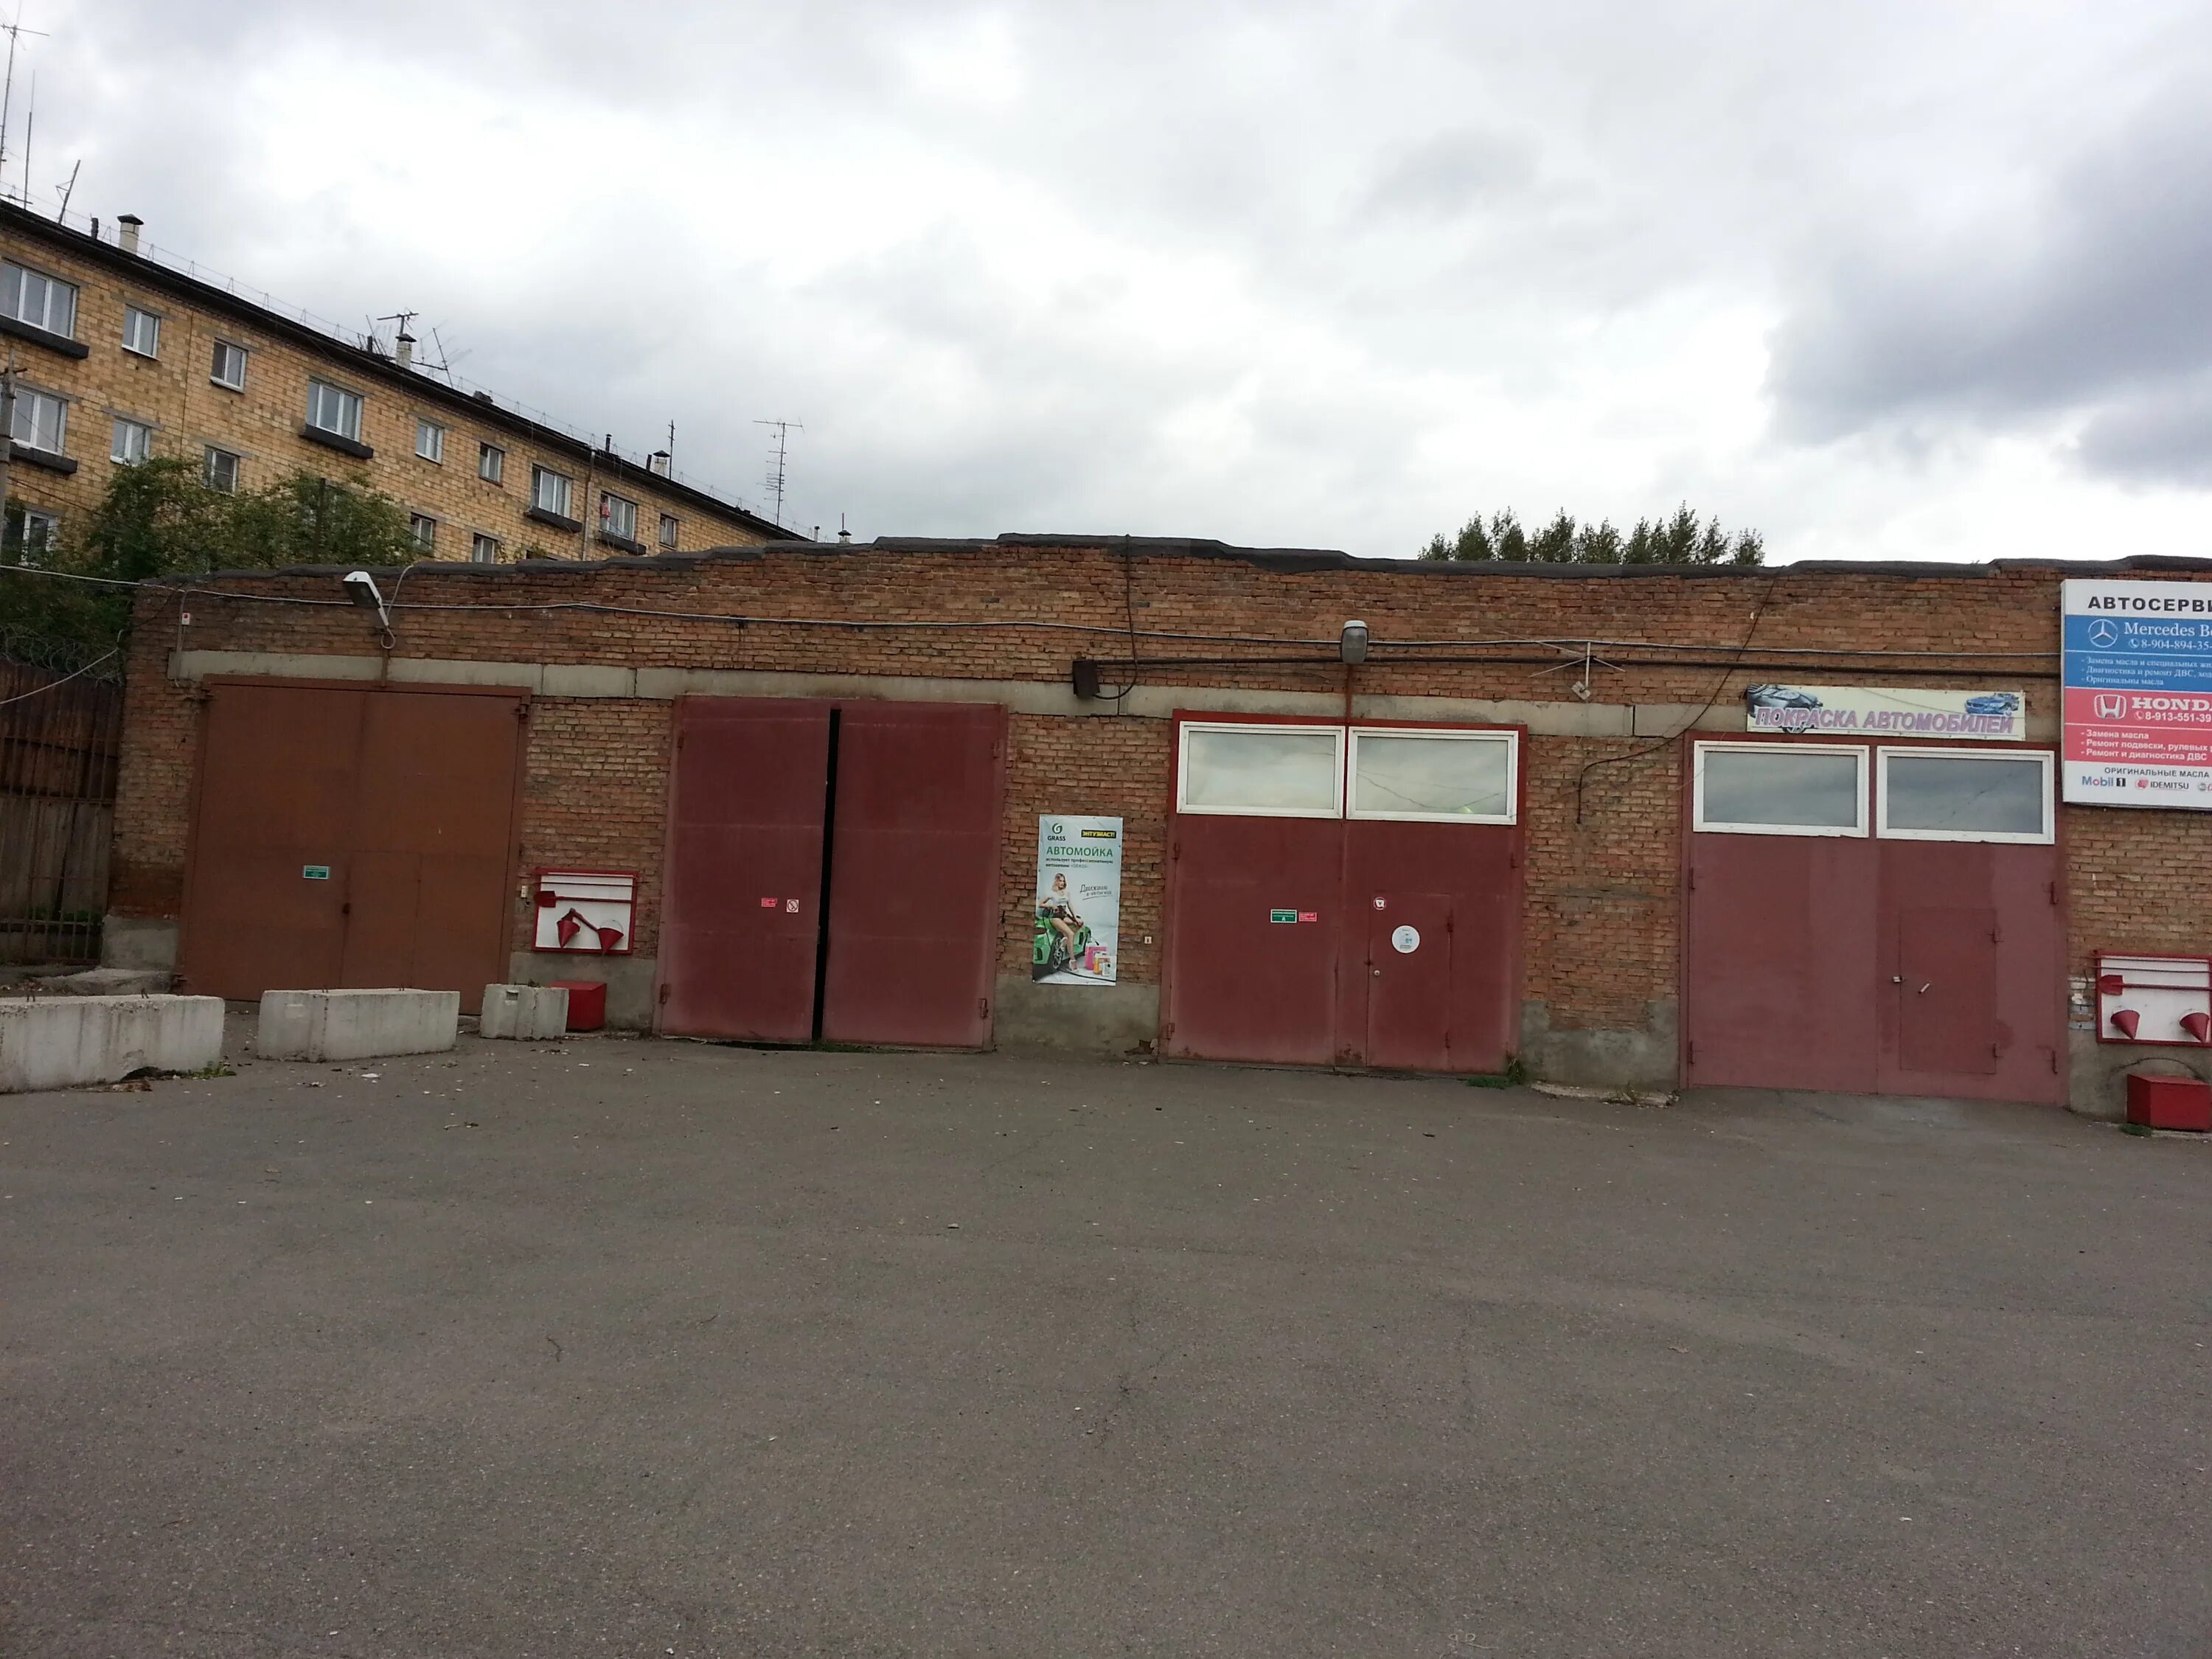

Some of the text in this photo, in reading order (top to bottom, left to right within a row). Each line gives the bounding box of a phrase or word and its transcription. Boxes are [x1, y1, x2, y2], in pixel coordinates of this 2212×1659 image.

[2124, 622, 2195, 636] Mercedes
[2086, 656, 2114, 665] Замена
[2086, 666, 2136, 675] Диагностика
[2132, 697, 2212, 712] HOND
[1755, 707, 2015, 734] ПОКРАСКА АВТОМОБИЛЕЙ
[2086, 729, 2119, 739] Замена
[2086, 739, 2119, 748] Ремонт
[2168, 743, 2208, 752] рулевых
[2086, 748, 2119, 757] Ремонт
[2129, 751, 2185, 761] диагностика
[2187, 753, 2208, 762] ДВС
[2104, 767, 2210, 779] ОРИГИНАЛЬНЫЕ МАСЛА
[2081, 776, 2114, 787] Mobil
[2150, 780, 2189, 790] IDEMITSU
[1046, 846, 1113, 857] АВТОМОЙКА
